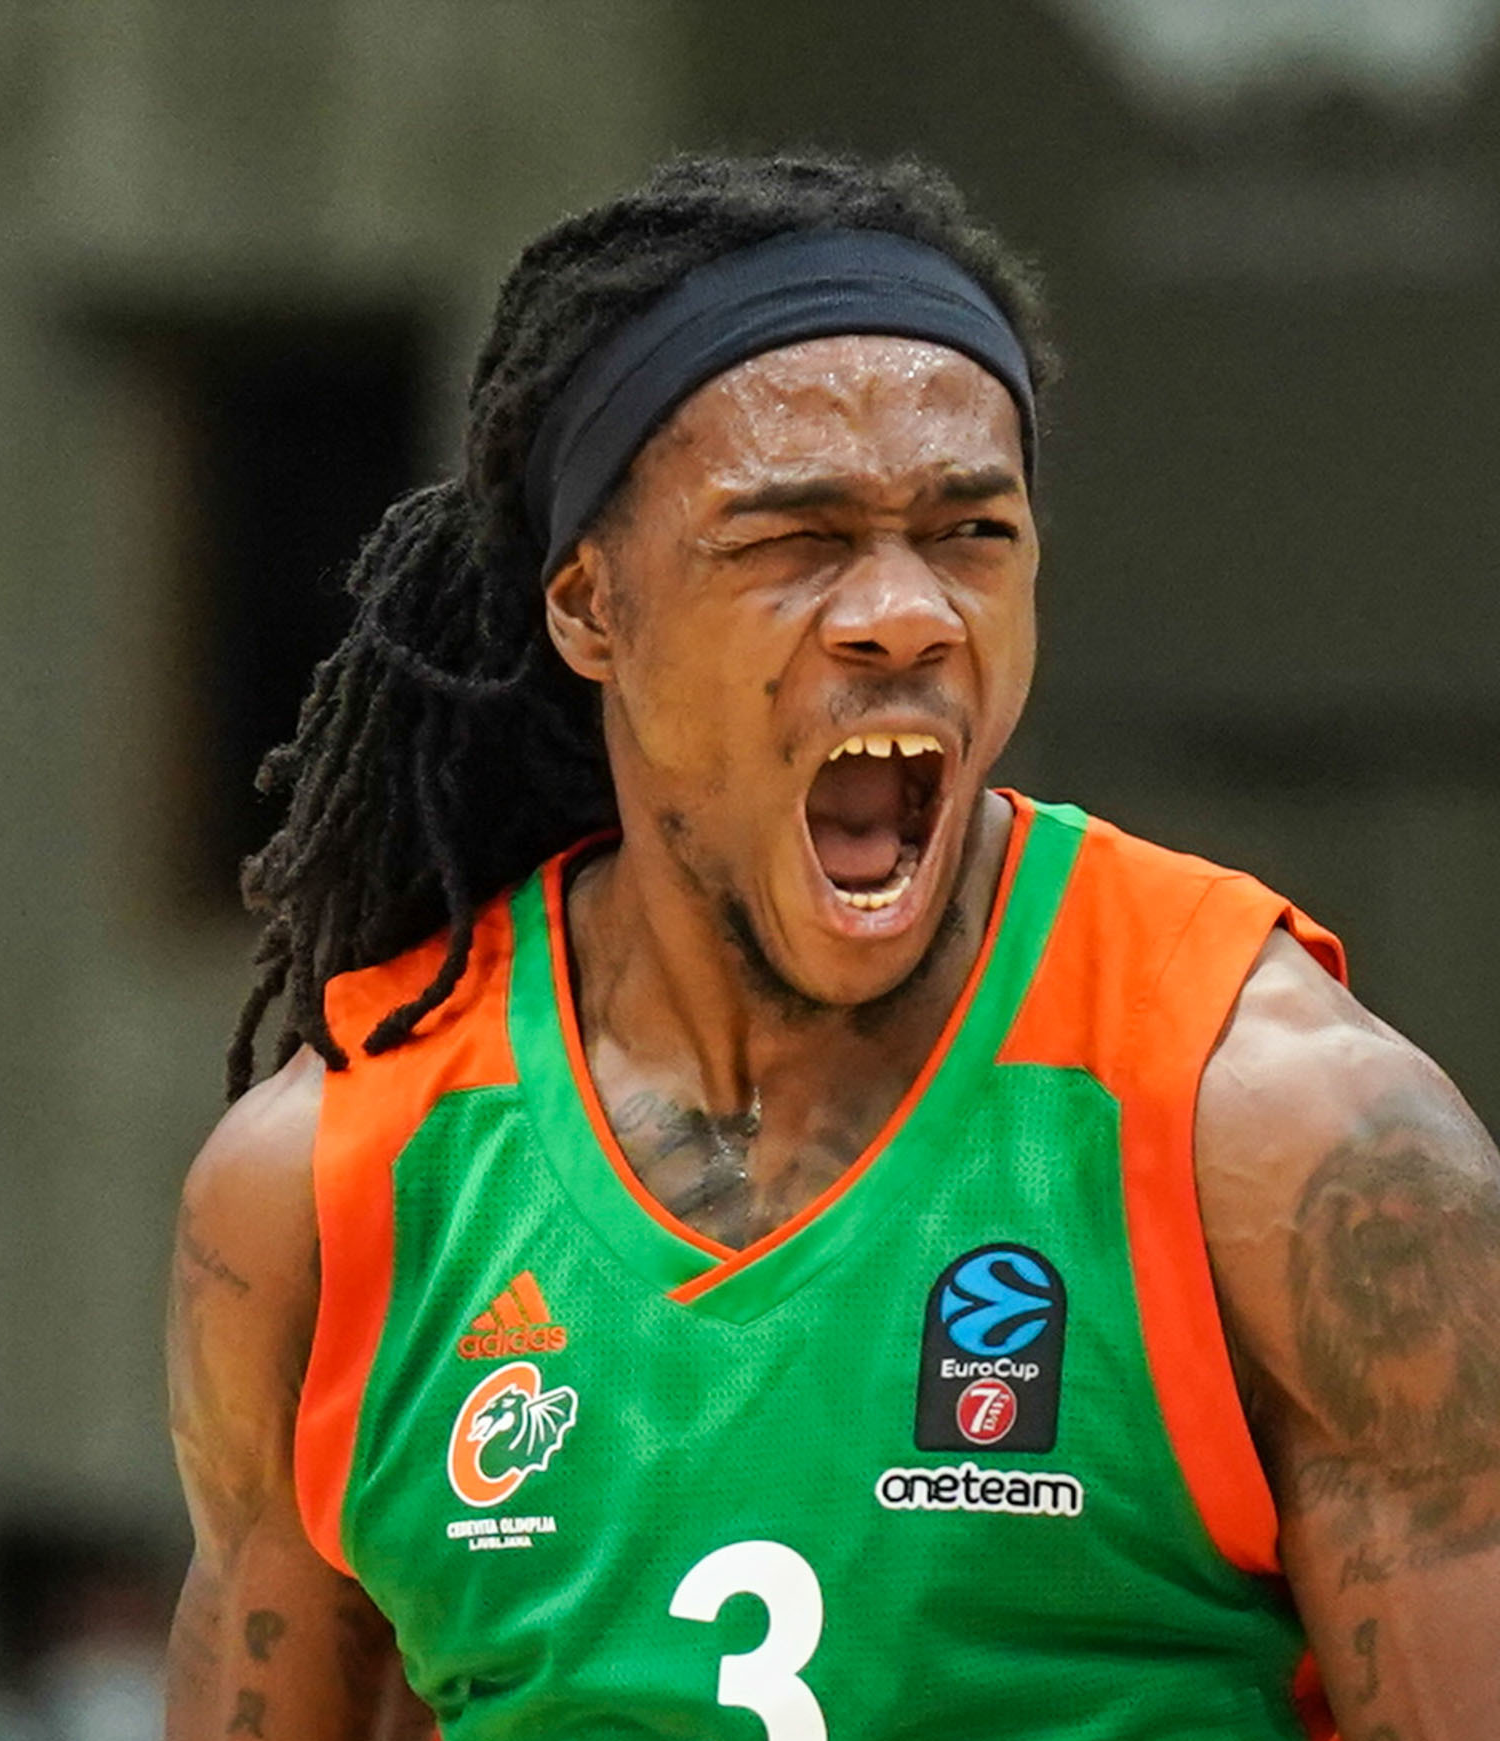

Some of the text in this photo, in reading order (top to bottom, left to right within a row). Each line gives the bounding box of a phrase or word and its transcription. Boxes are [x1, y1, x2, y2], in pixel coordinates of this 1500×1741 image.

[457, 1323, 567, 1359] adidas
[940, 1357, 1040, 1382] EuroCup
[968, 1387, 1001, 1434] 7
[882, 1468, 1078, 1511] oneteam
